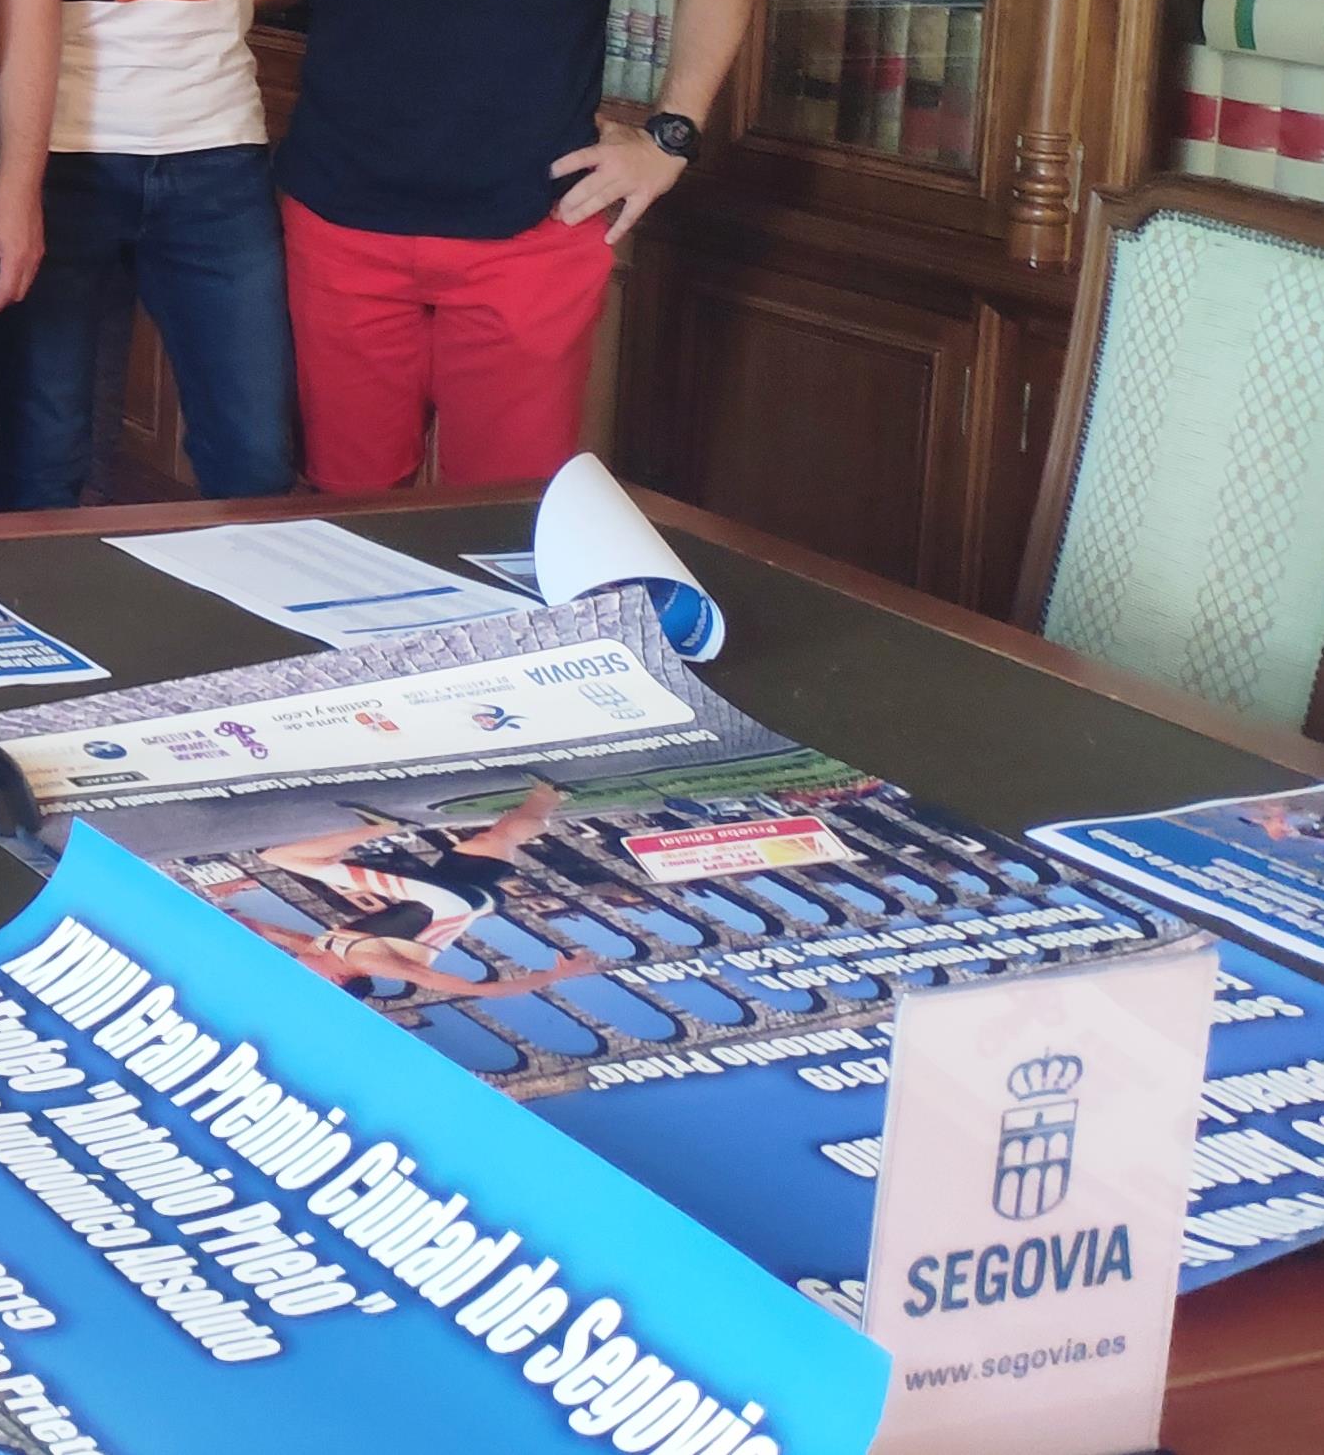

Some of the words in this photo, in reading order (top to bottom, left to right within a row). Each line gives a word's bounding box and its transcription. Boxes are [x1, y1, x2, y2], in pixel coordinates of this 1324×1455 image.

[523, 652, 631, 686] SEGOVIA
[324, 699, 384, 716] Castilla
[283, 720, 304, 733] de
[308, 714, 350, 731] Junta
[659, 830, 715, 848] Oficial
[717, 823, 778, 838] Prueba
[953, 918, 999, 936] de
[986, 903, 1104, 930] Pruebas
[798, 931, 908, 957] Premio:
[898, 923, 967, 945] Gran
[991, 938, 1039, 956] de
[1026, 922, 1146, 950] Pruebas
[643, 957, 721, 983] 21:00
[850, 943, 1007, 978] Promoción:
[0, 915, 152, 1033] XXVIII
[92, 984, 221, 1094] Gran
[169, 1041, 353, 1192] Premio
[307, 1141, 523, 1309] Ciudad
[454, 1256, 571, 1356] de
[902, 1224, 1133, 1318] SEGOVIA
[103, 1244, 282, 1363] Absoluto
[904, 1333, 1127, 1393] www.segovia.es
